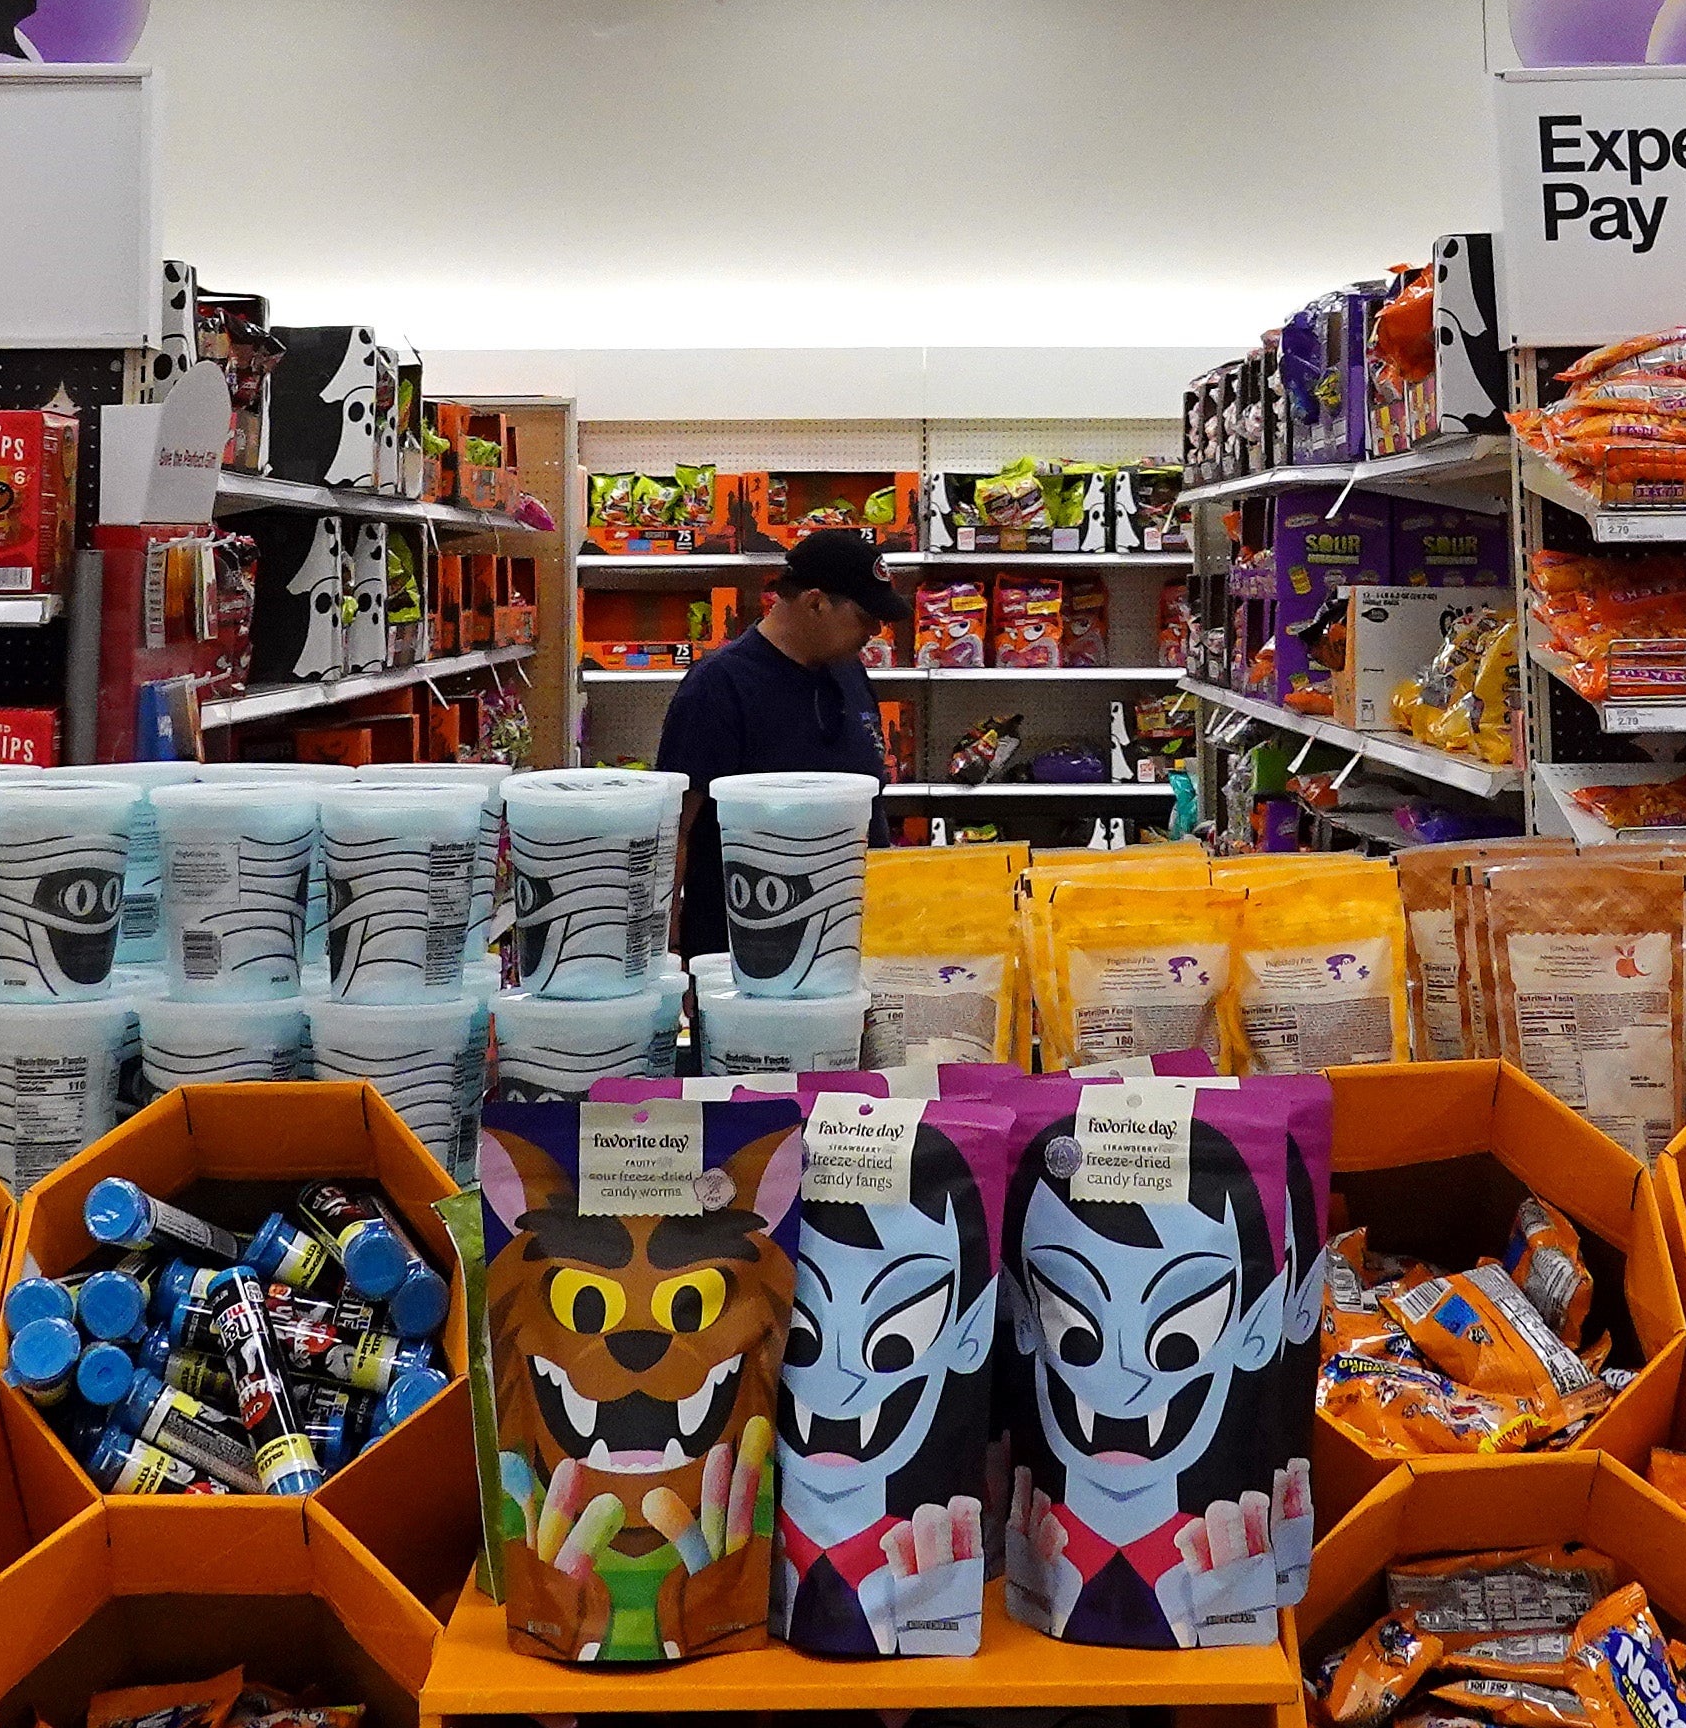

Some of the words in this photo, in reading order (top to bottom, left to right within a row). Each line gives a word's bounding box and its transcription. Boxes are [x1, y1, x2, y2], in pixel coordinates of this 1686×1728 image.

[1542, 182, 1668, 254] Pay
[677, 530, 692, 542] 75
[859, 527, 874, 540] 75
[1305, 533, 1362, 554] SOUR
[1422, 535, 1479, 556] SOUR
[675, 644, 690, 656] 75
[15, 1056, 60, 1068] Nutrition
[817, 1120, 875, 1139] favorite
[876, 1123, 905, 1141] day
[1087, 1117, 1145, 1136] favorite
[1145, 1119, 1178, 1140] day
[593, 1132, 657, 1151] favorite
[658, 1133, 689, 1153] day
[812, 1152, 893, 1171] freeze-dried
[1086, 1152, 1172, 1170] freeze-dried
[813, 1172, 853, 1190] candy
[855, 1172, 893, 1191] fangs
[1086, 1172, 1130, 1189] candy
[1131, 1172, 1174, 1190] fangs
[600, 1185, 637, 1200] candy
[638, 1187, 682, 1198] worms
